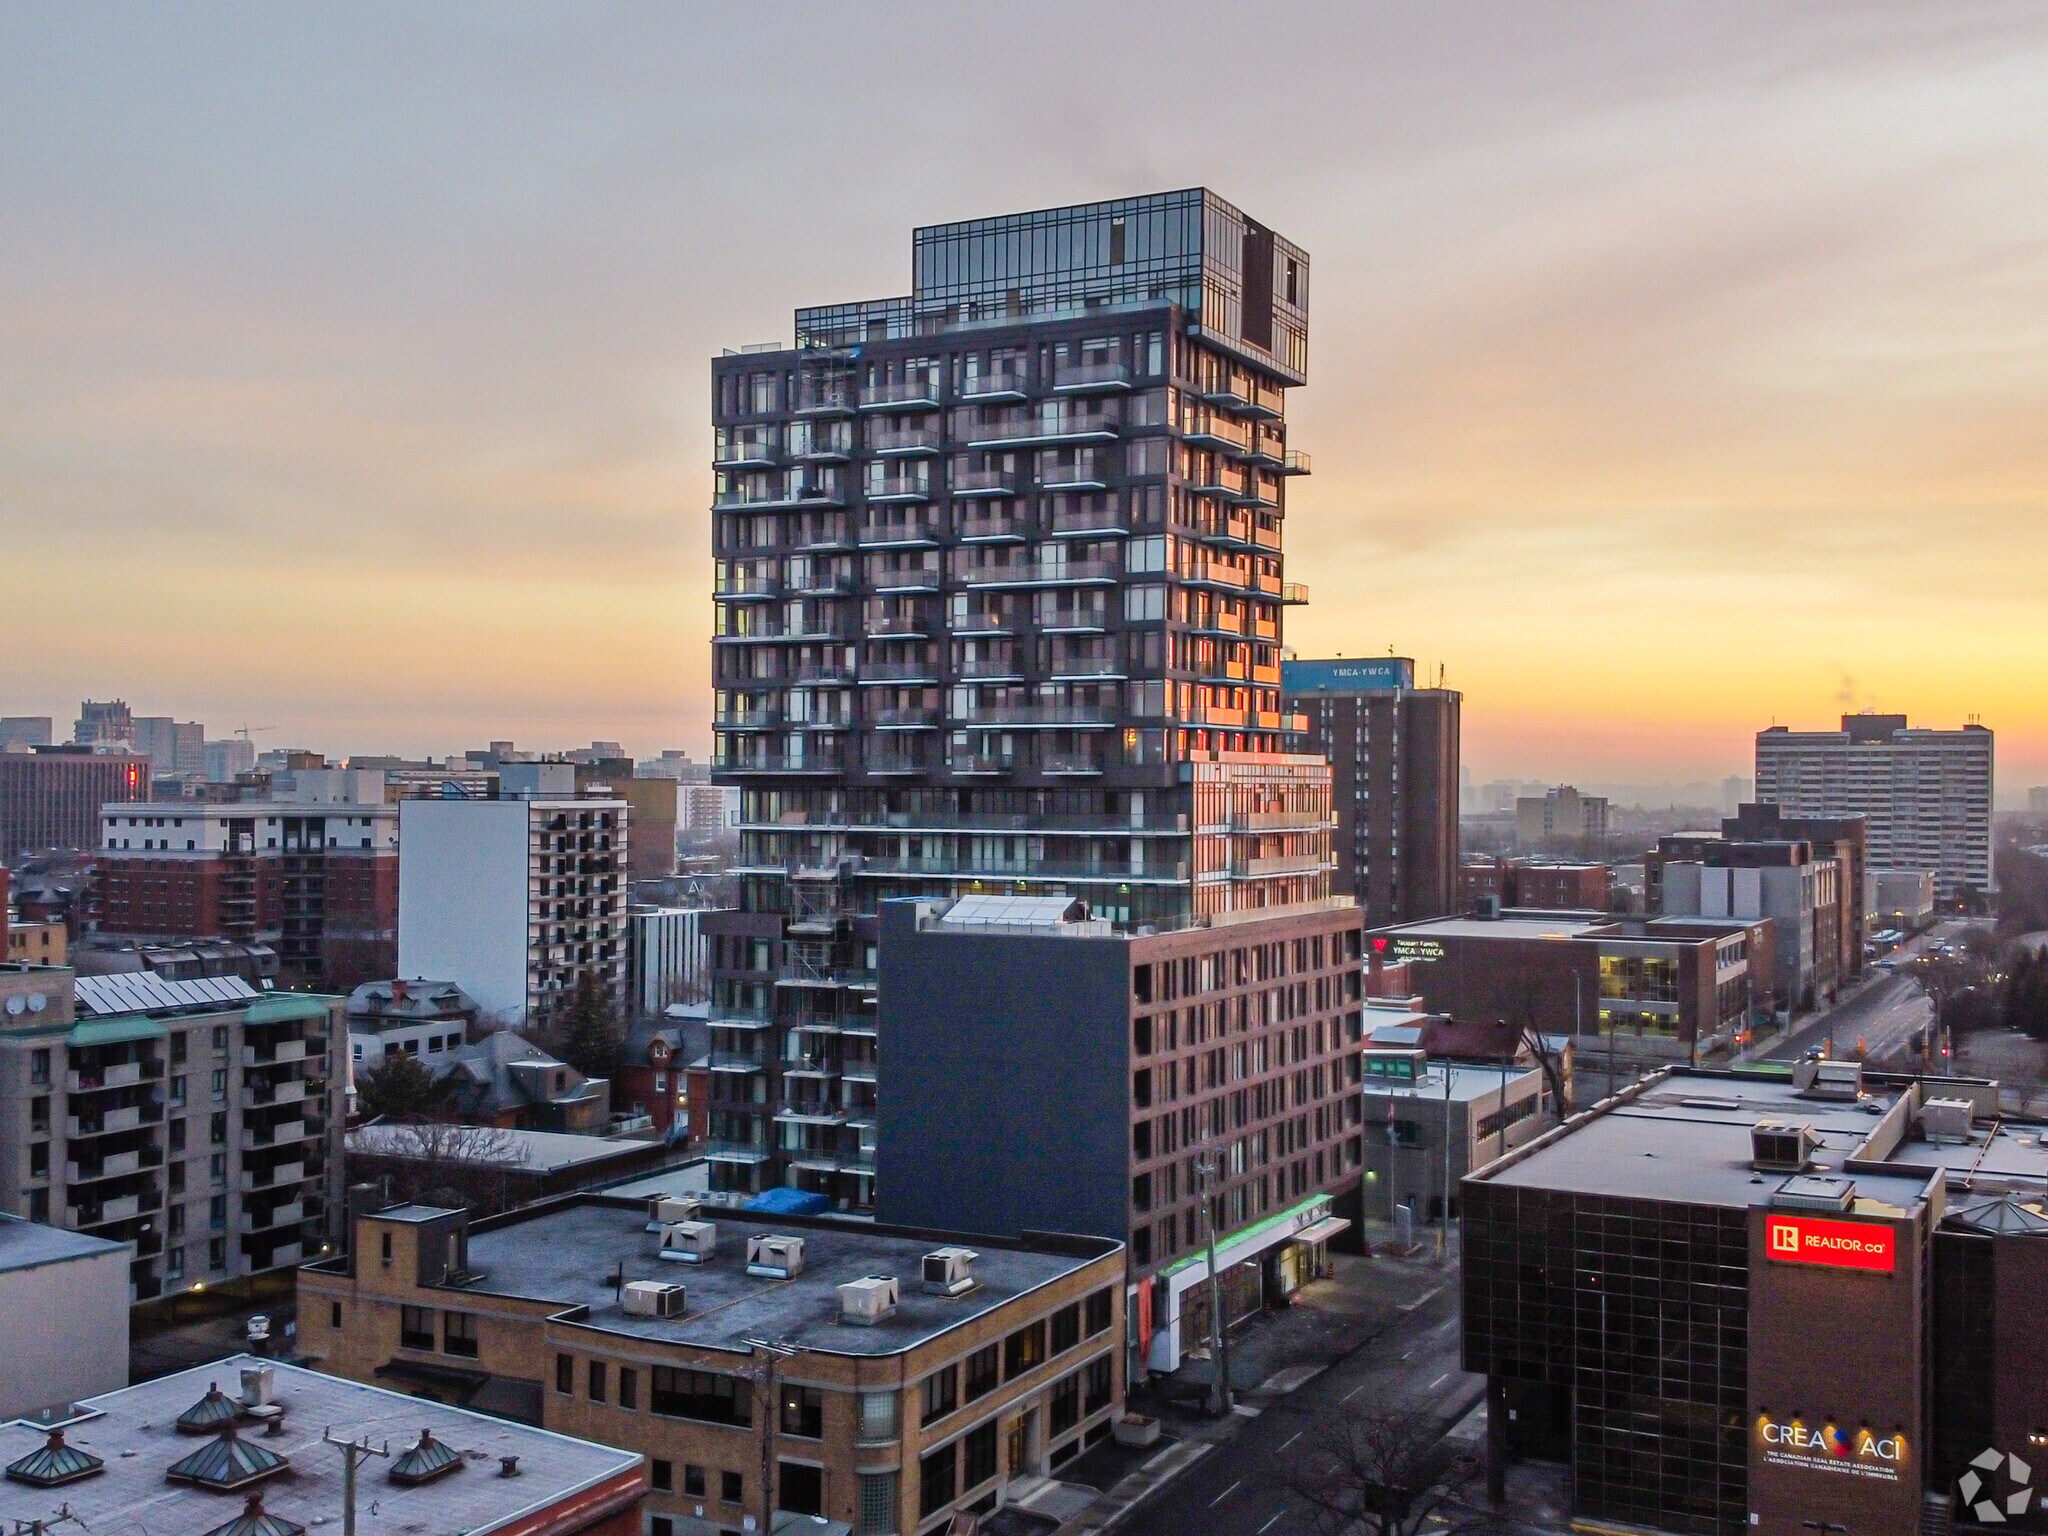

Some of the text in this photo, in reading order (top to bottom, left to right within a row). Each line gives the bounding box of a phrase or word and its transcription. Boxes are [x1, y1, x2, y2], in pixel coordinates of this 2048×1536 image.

[1806, 1236, 1883, 1253] REALTOR.ca
[1762, 1423, 1900, 1460] CREA ACI
[1763, 1457, 1809, 1467] L'ASSOCIATION
[1779, 1452, 1812, 1462] CANADIAN
[1852, 1463, 1895, 1473] ASSOCIATION
